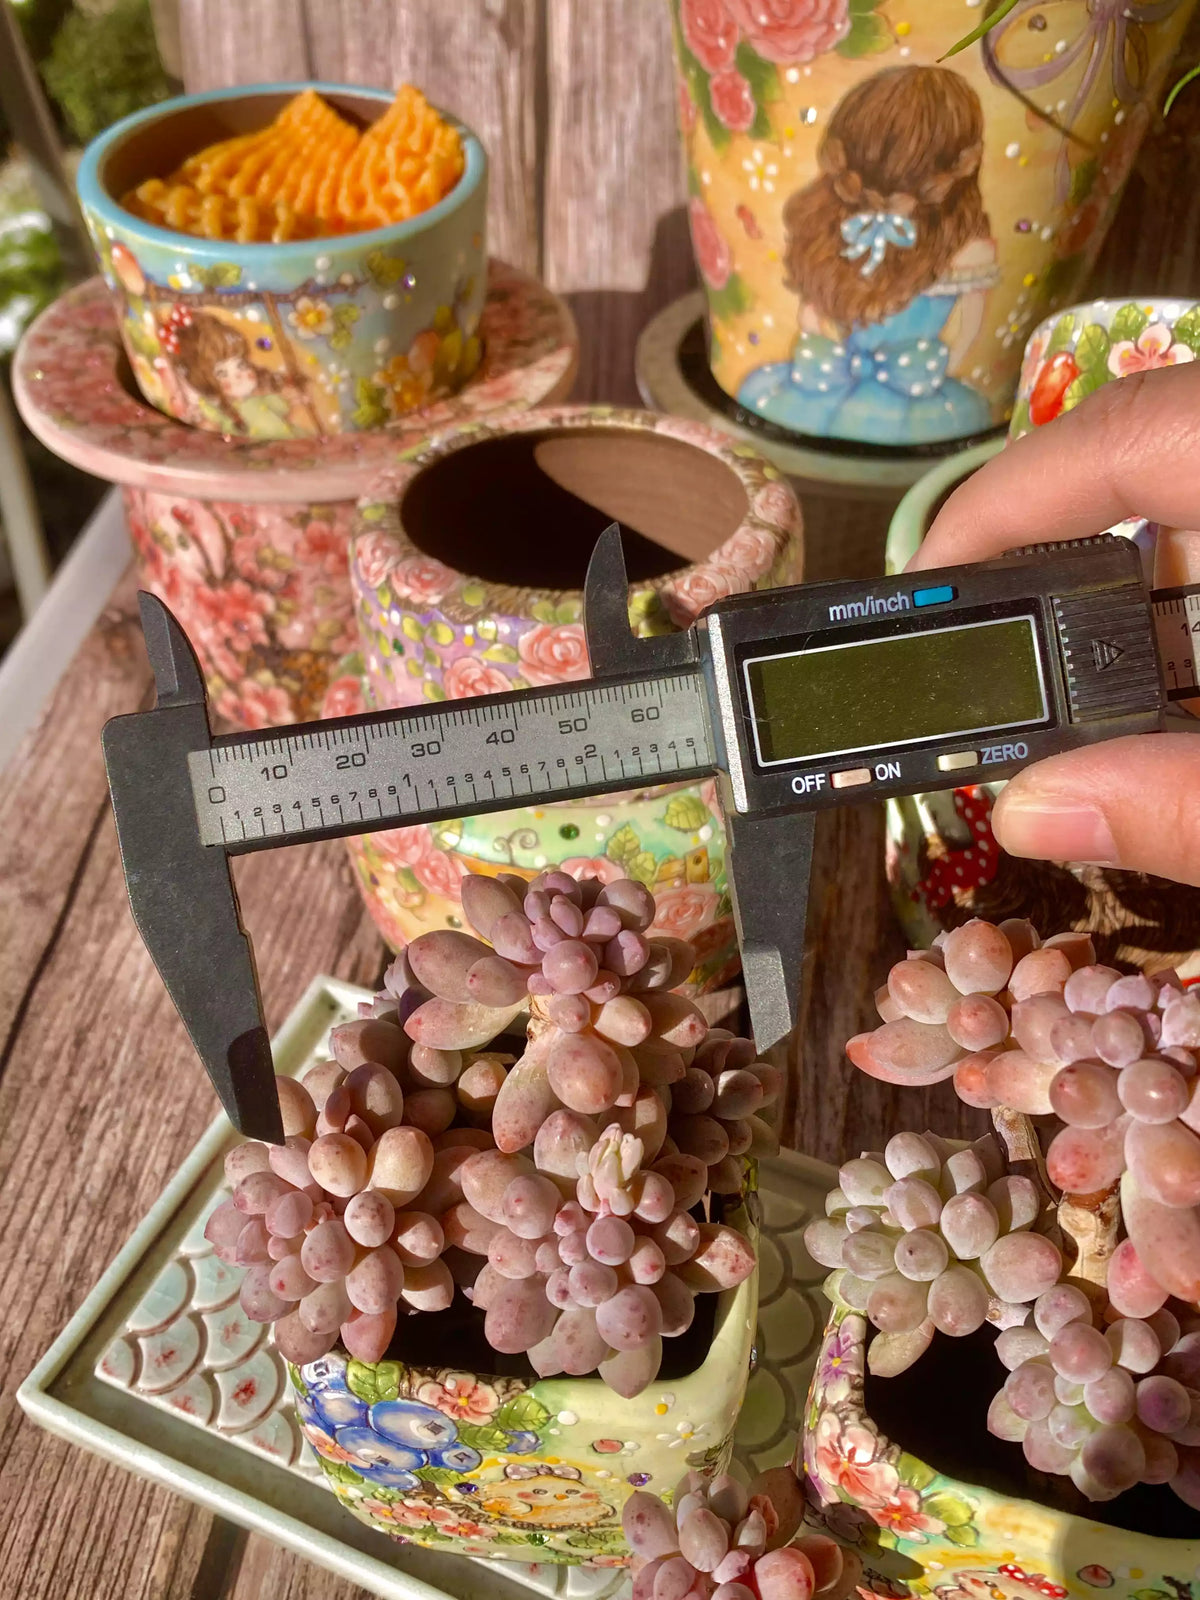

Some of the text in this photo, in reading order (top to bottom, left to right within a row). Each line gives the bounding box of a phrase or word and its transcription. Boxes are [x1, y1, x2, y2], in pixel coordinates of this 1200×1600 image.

[828, 591, 911, 621] mm/inch
[1167, 658, 1192, 671] 2 3
[208, 706, 660, 804] 0 10 20 30 40 50 60
[253, 807, 263, 817] 2
[272, 804, 282, 813] 3
[292, 801, 301, 810] 4
[311, 797, 321, 807] 5
[331, 795, 340, 804] 6
[348, 791, 357, 801] 7
[368, 789, 377, 798] 8
[387, 785, 397, 795] 9
[446, 776, 455, 786] 2
[464, 773, 474, 782] 3
[483, 770, 492, 779] 4
[502, 767, 511, 776] 5
[520, 764, 529, 773] 6
[538, 761, 546, 771] 7
[556, 759, 565, 768] 8
[575, 755, 584, 765] 9
[584, 744, 598, 758] 2
[631, 746, 640, 756] 2
[650, 744, 658, 753] 3
[668, 741, 676, 750] 4
[686, 737, 695, 747] 5
[791, 742, 1028, 794] OFF ON ZERO
